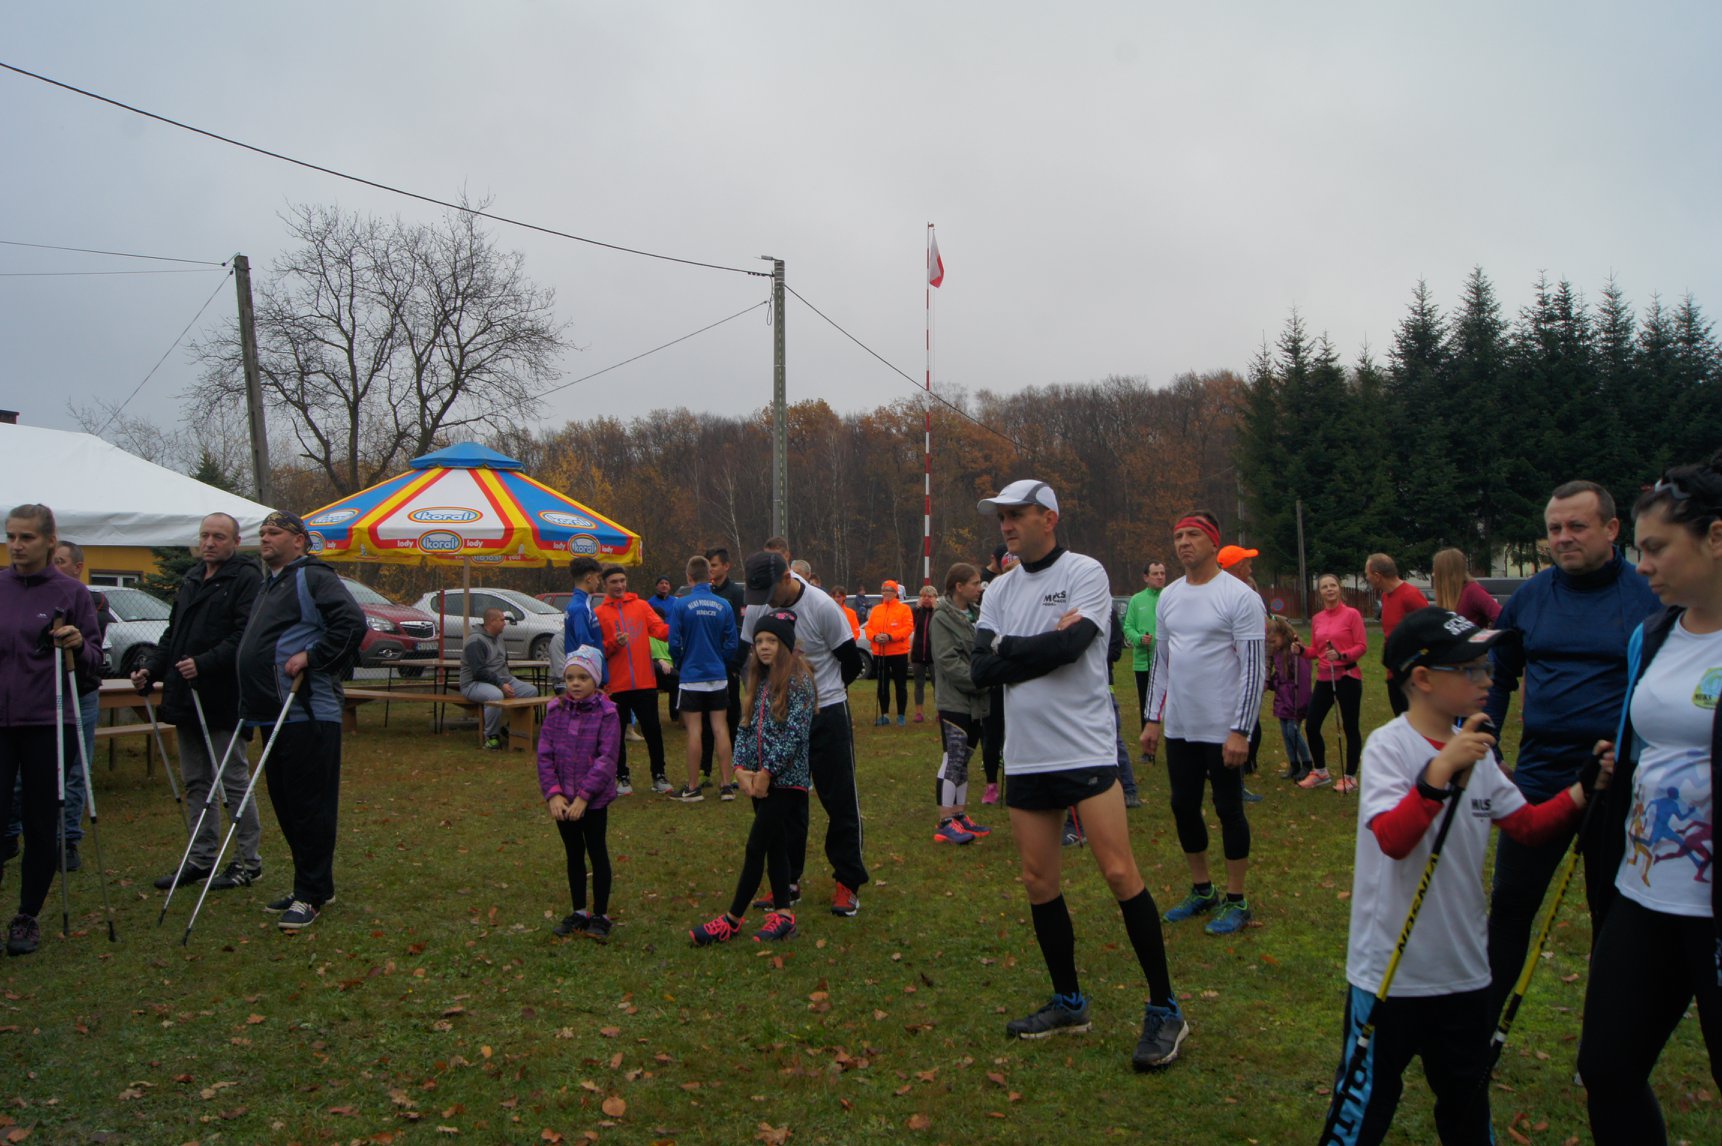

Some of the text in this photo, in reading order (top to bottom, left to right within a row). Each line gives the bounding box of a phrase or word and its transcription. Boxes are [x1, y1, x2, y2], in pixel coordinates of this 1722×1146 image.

[421, 510, 471, 521] koral
[397, 538, 484, 549] lody koral lody
[553, 542, 614, 554] lody koral lody
